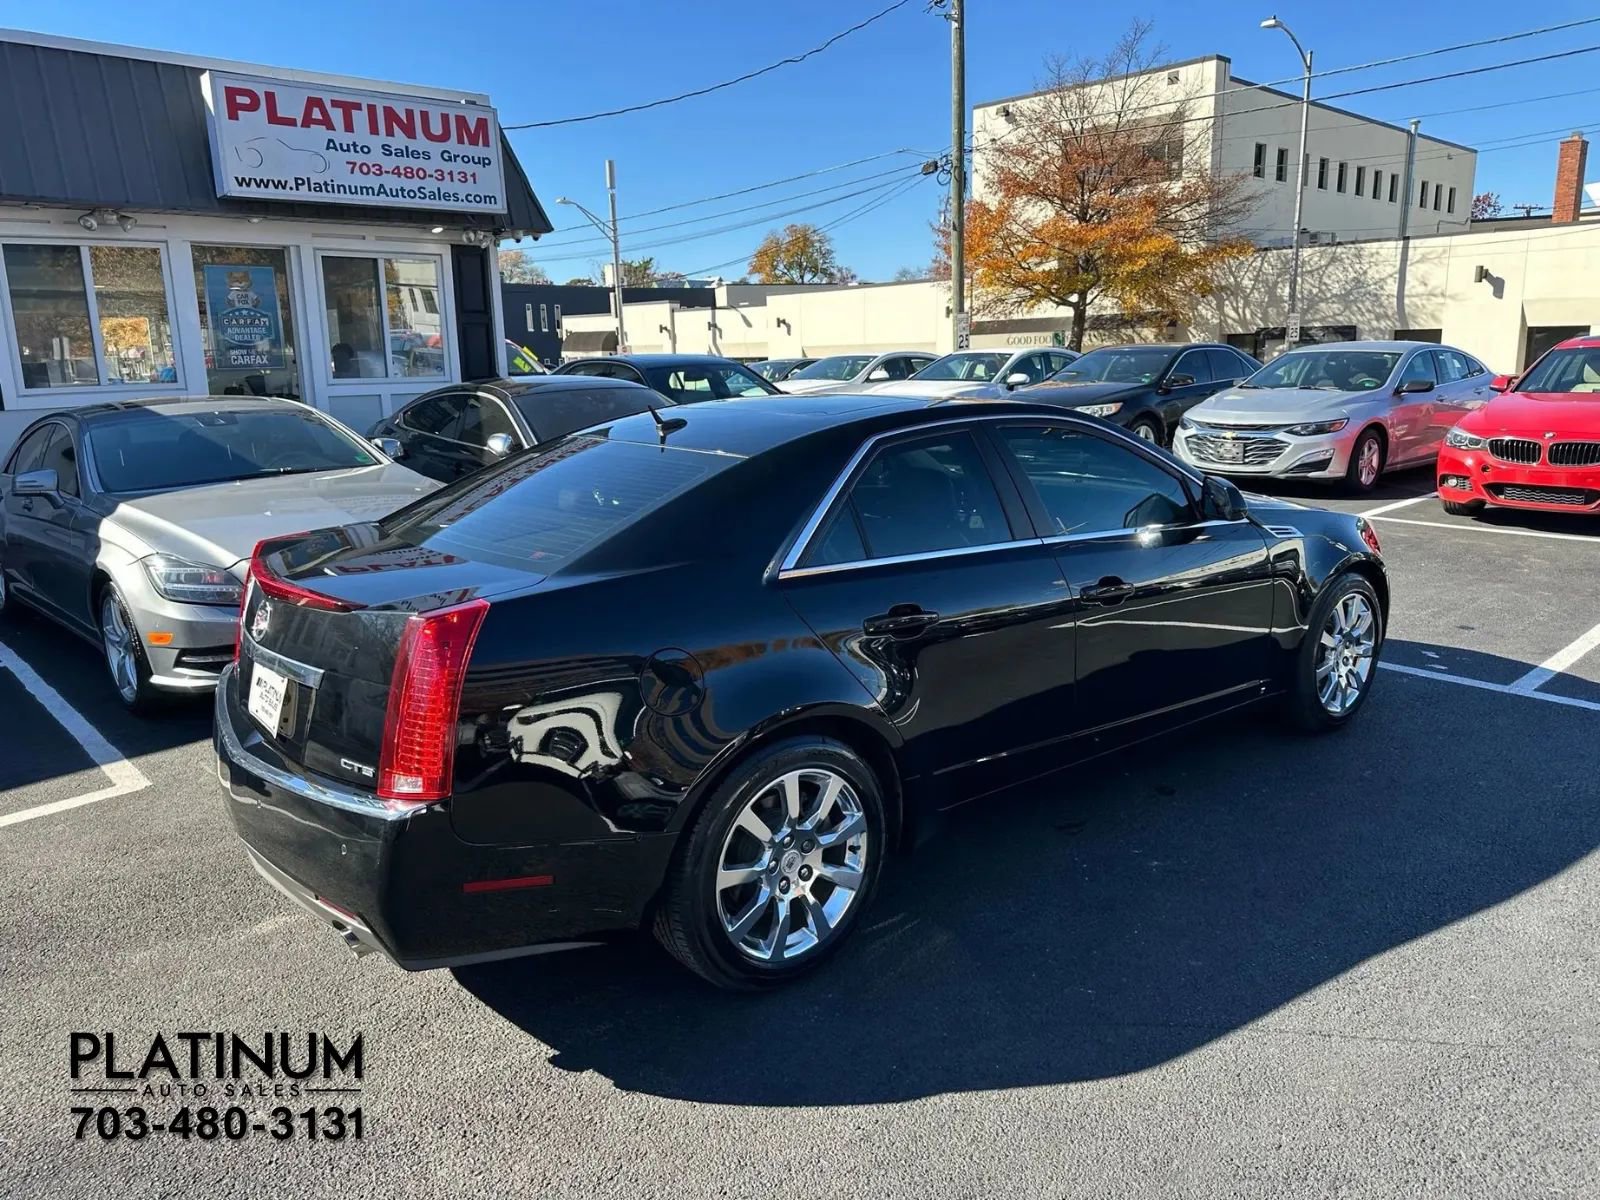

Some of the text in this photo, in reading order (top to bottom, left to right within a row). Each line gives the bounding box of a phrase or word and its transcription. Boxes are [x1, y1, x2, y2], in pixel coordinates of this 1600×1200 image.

[223, 86, 491, 148] PLATINUM
[325, 138, 492, 167] Auto Sales Group
[345, 161, 478, 184] 703-480-3131
[234, 175, 498, 205] www.PlatinumAutoSales.com
[223, 317, 269, 326] CARFAX
[958, 334, 969, 349] 25
[1007, 335, 1052, 346] GOOD FOO
[231, 355, 269, 365] CARFAX
[341, 758, 376, 778] CTS
